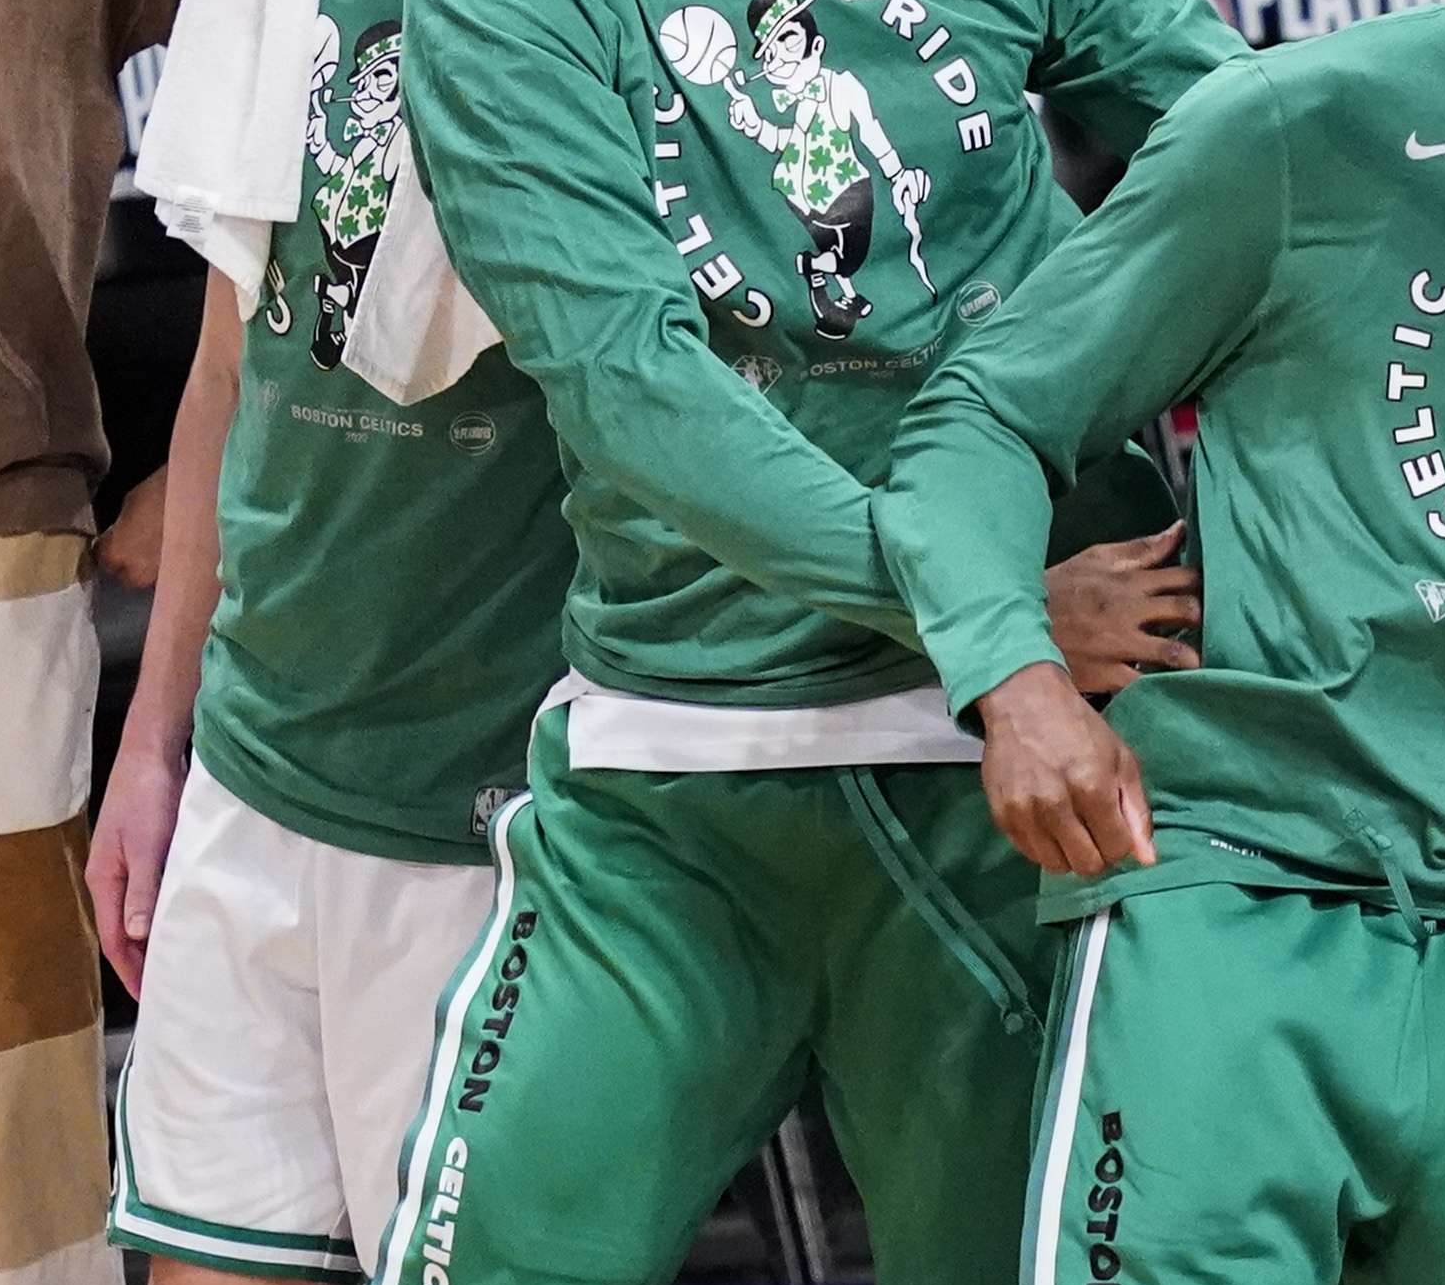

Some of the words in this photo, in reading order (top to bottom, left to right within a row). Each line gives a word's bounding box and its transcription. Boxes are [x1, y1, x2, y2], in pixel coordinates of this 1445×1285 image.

[653, 86, 774, 328] CELTIC
[290, 404, 353, 428] BOSTON
[360, 415, 424, 437] CELTICS
[457, 910, 538, 1113] BOSTON
